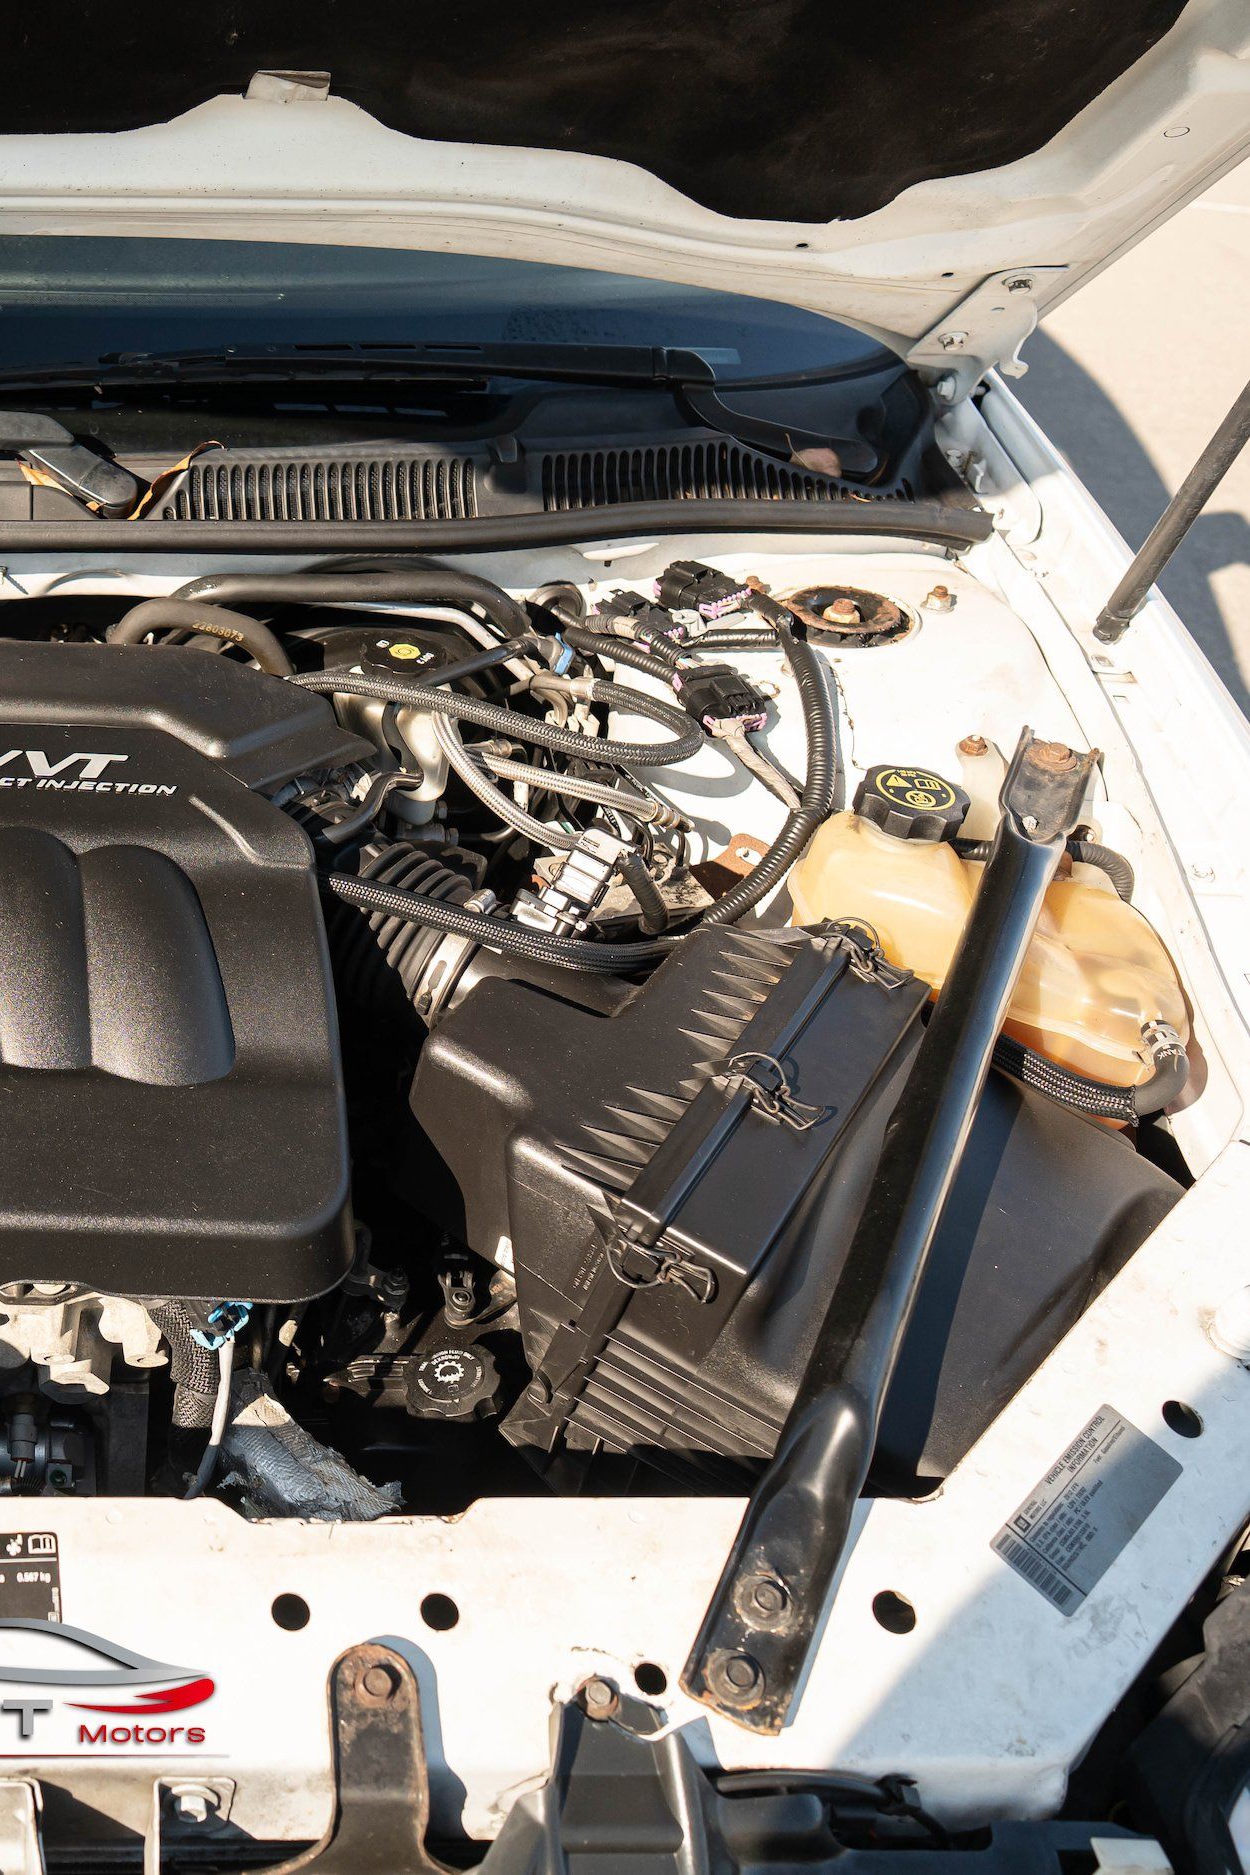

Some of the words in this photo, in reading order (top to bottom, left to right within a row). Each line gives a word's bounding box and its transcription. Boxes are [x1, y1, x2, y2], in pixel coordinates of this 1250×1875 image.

[37, 778, 178, 796] INJECTION
[1045, 1461, 1066, 1485] VEHICLE
[1063, 1437, 1086, 1463] EMISSION
[1083, 1414, 1105, 1439] CONTROL
[1067, 1436, 1098, 1473] INFORMATION
